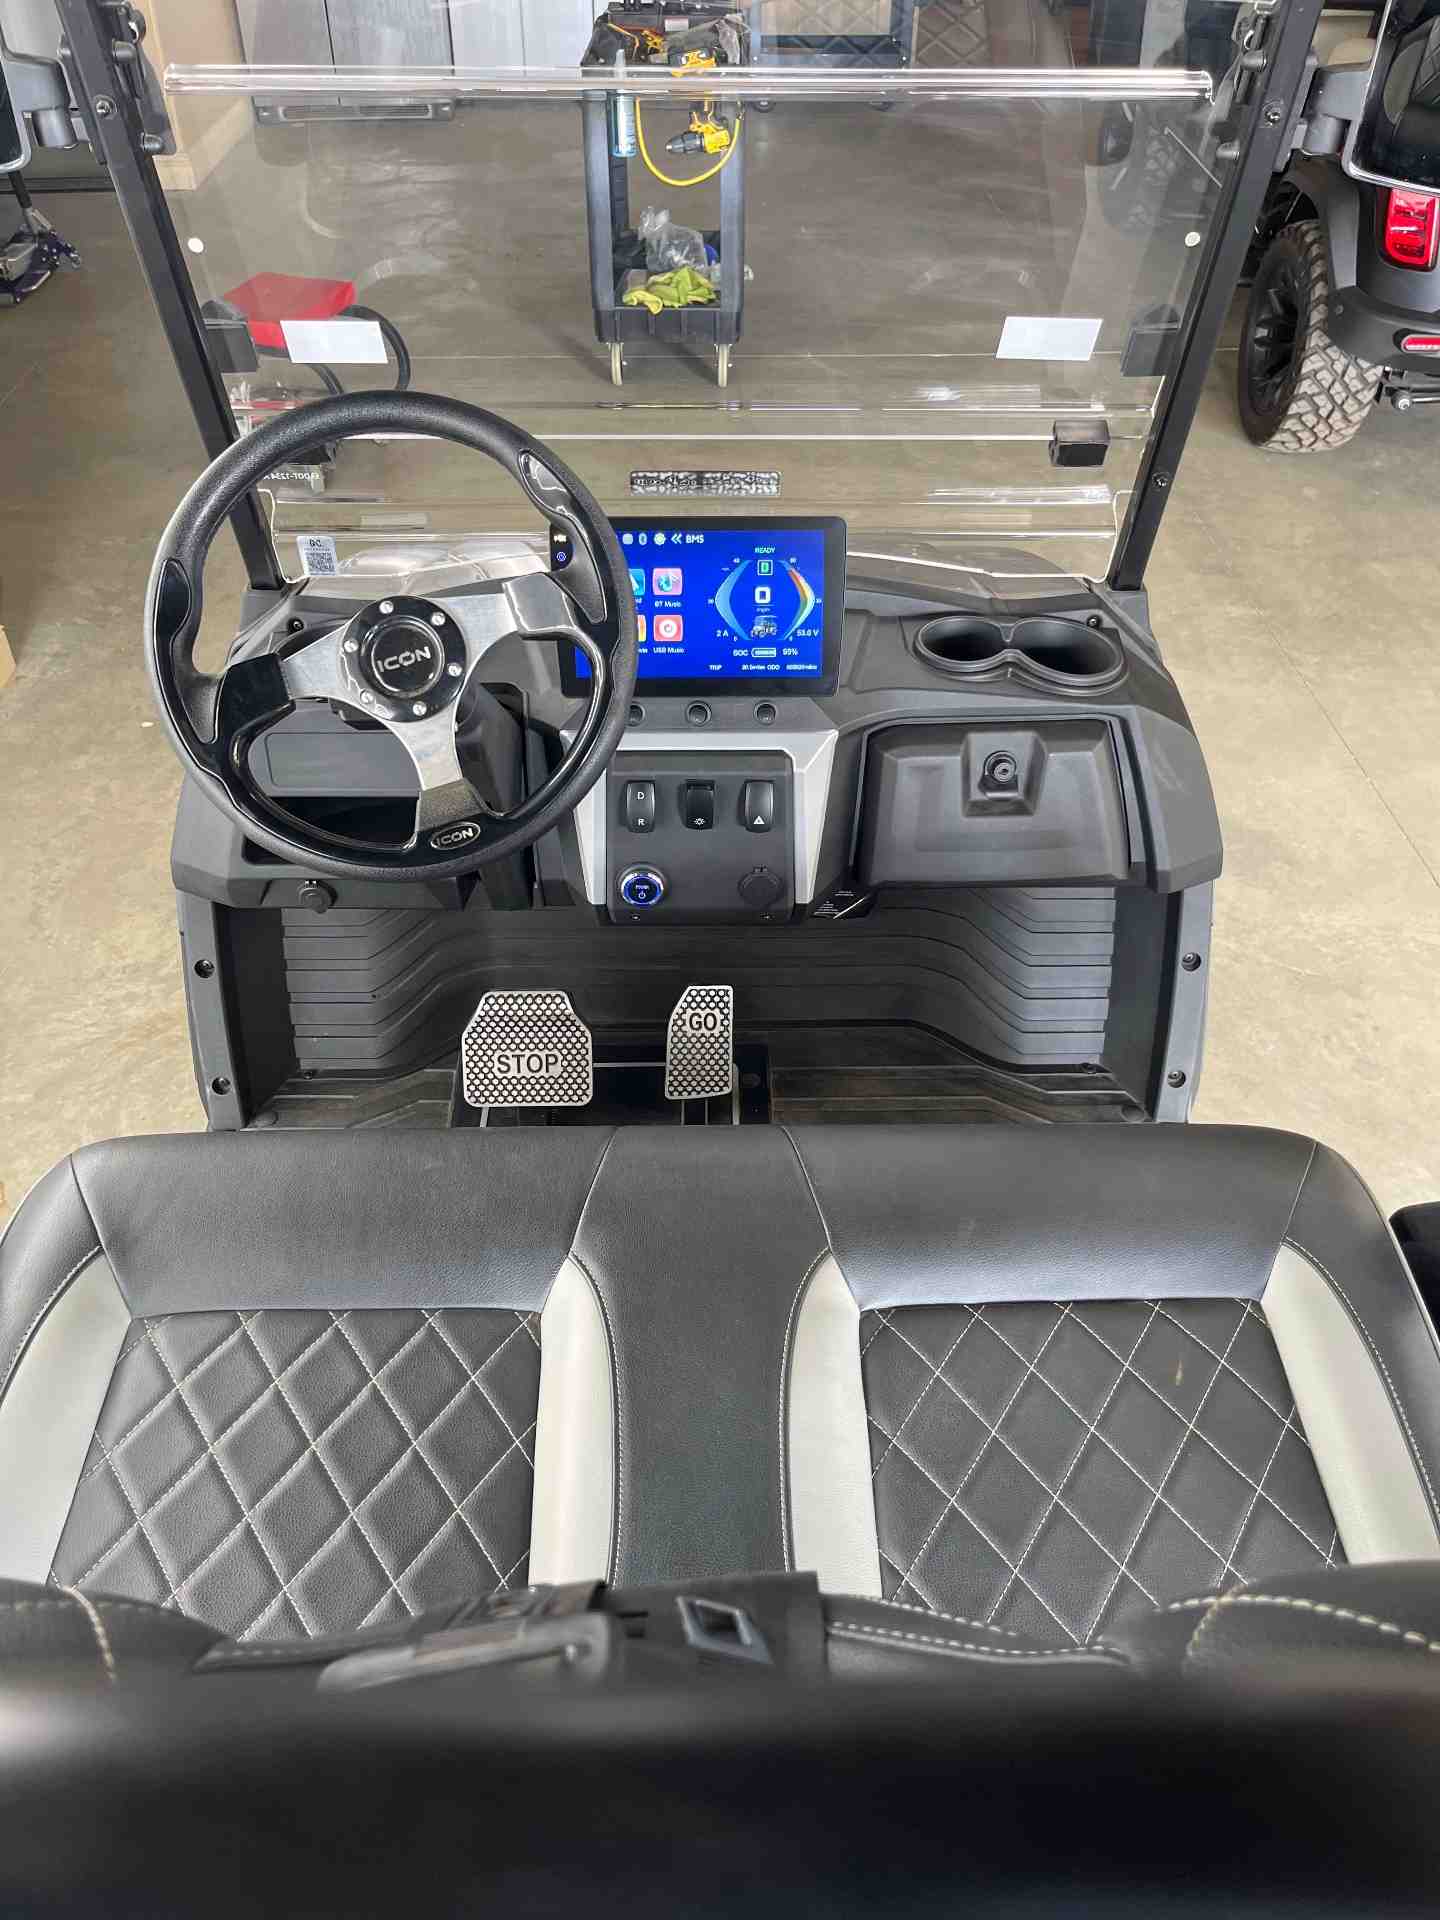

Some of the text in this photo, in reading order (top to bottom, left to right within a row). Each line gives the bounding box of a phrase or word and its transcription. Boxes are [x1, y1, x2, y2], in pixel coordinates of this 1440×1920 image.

[685, 534, 705, 545] BMS
[754, 586, 771, 604] 0
[664, 600, 682, 608] Music
[667, 646, 685, 654] Music
[733, 648, 749, 657] SOC
[376, 646, 432, 673] ICON
[637, 791, 645, 800] D
[638, 817, 646, 826] R
[437, 827, 474, 846] ICON
[689, 1012, 718, 1031] GO
[497, 1053, 559, 1075] STOP
